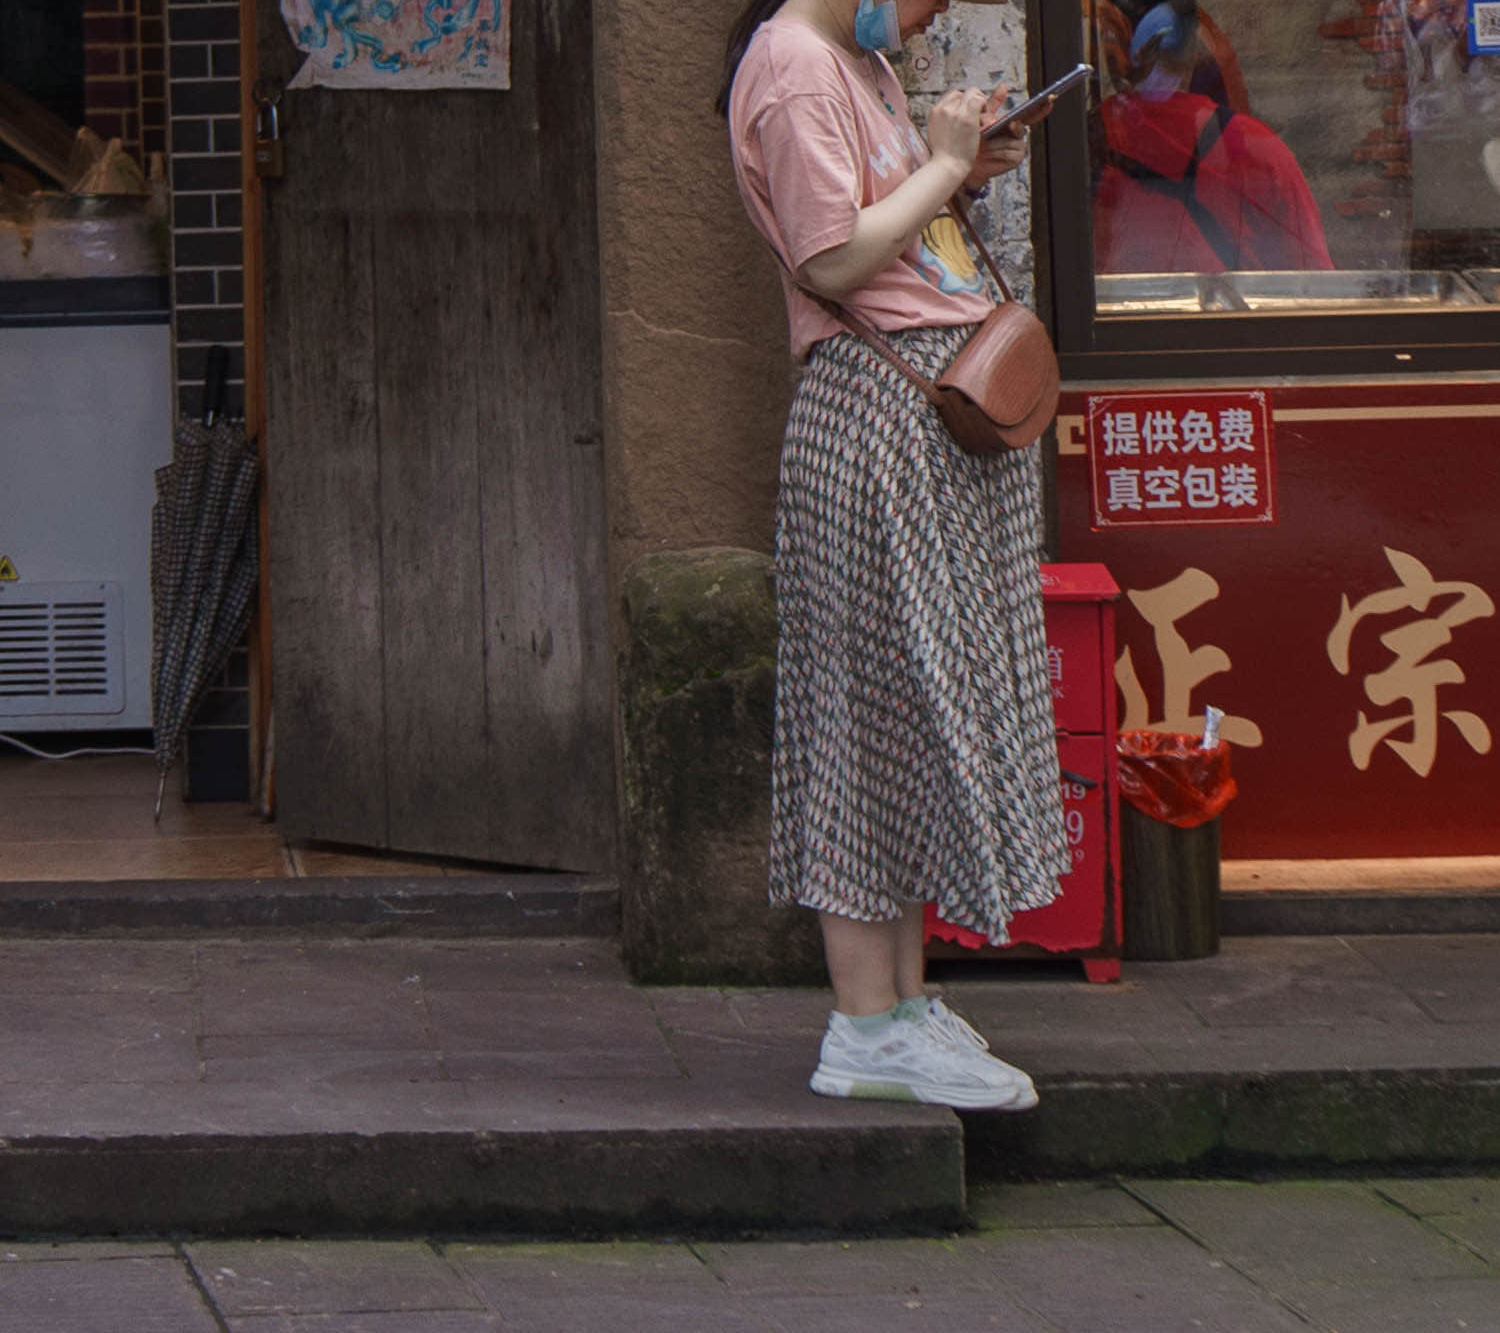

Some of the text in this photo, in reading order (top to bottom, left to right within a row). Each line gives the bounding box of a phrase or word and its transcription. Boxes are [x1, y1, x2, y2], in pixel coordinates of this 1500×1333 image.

[1102, 407, 1256, 456] 提供免费
[1105, 464, 1259, 512] 真空包装
